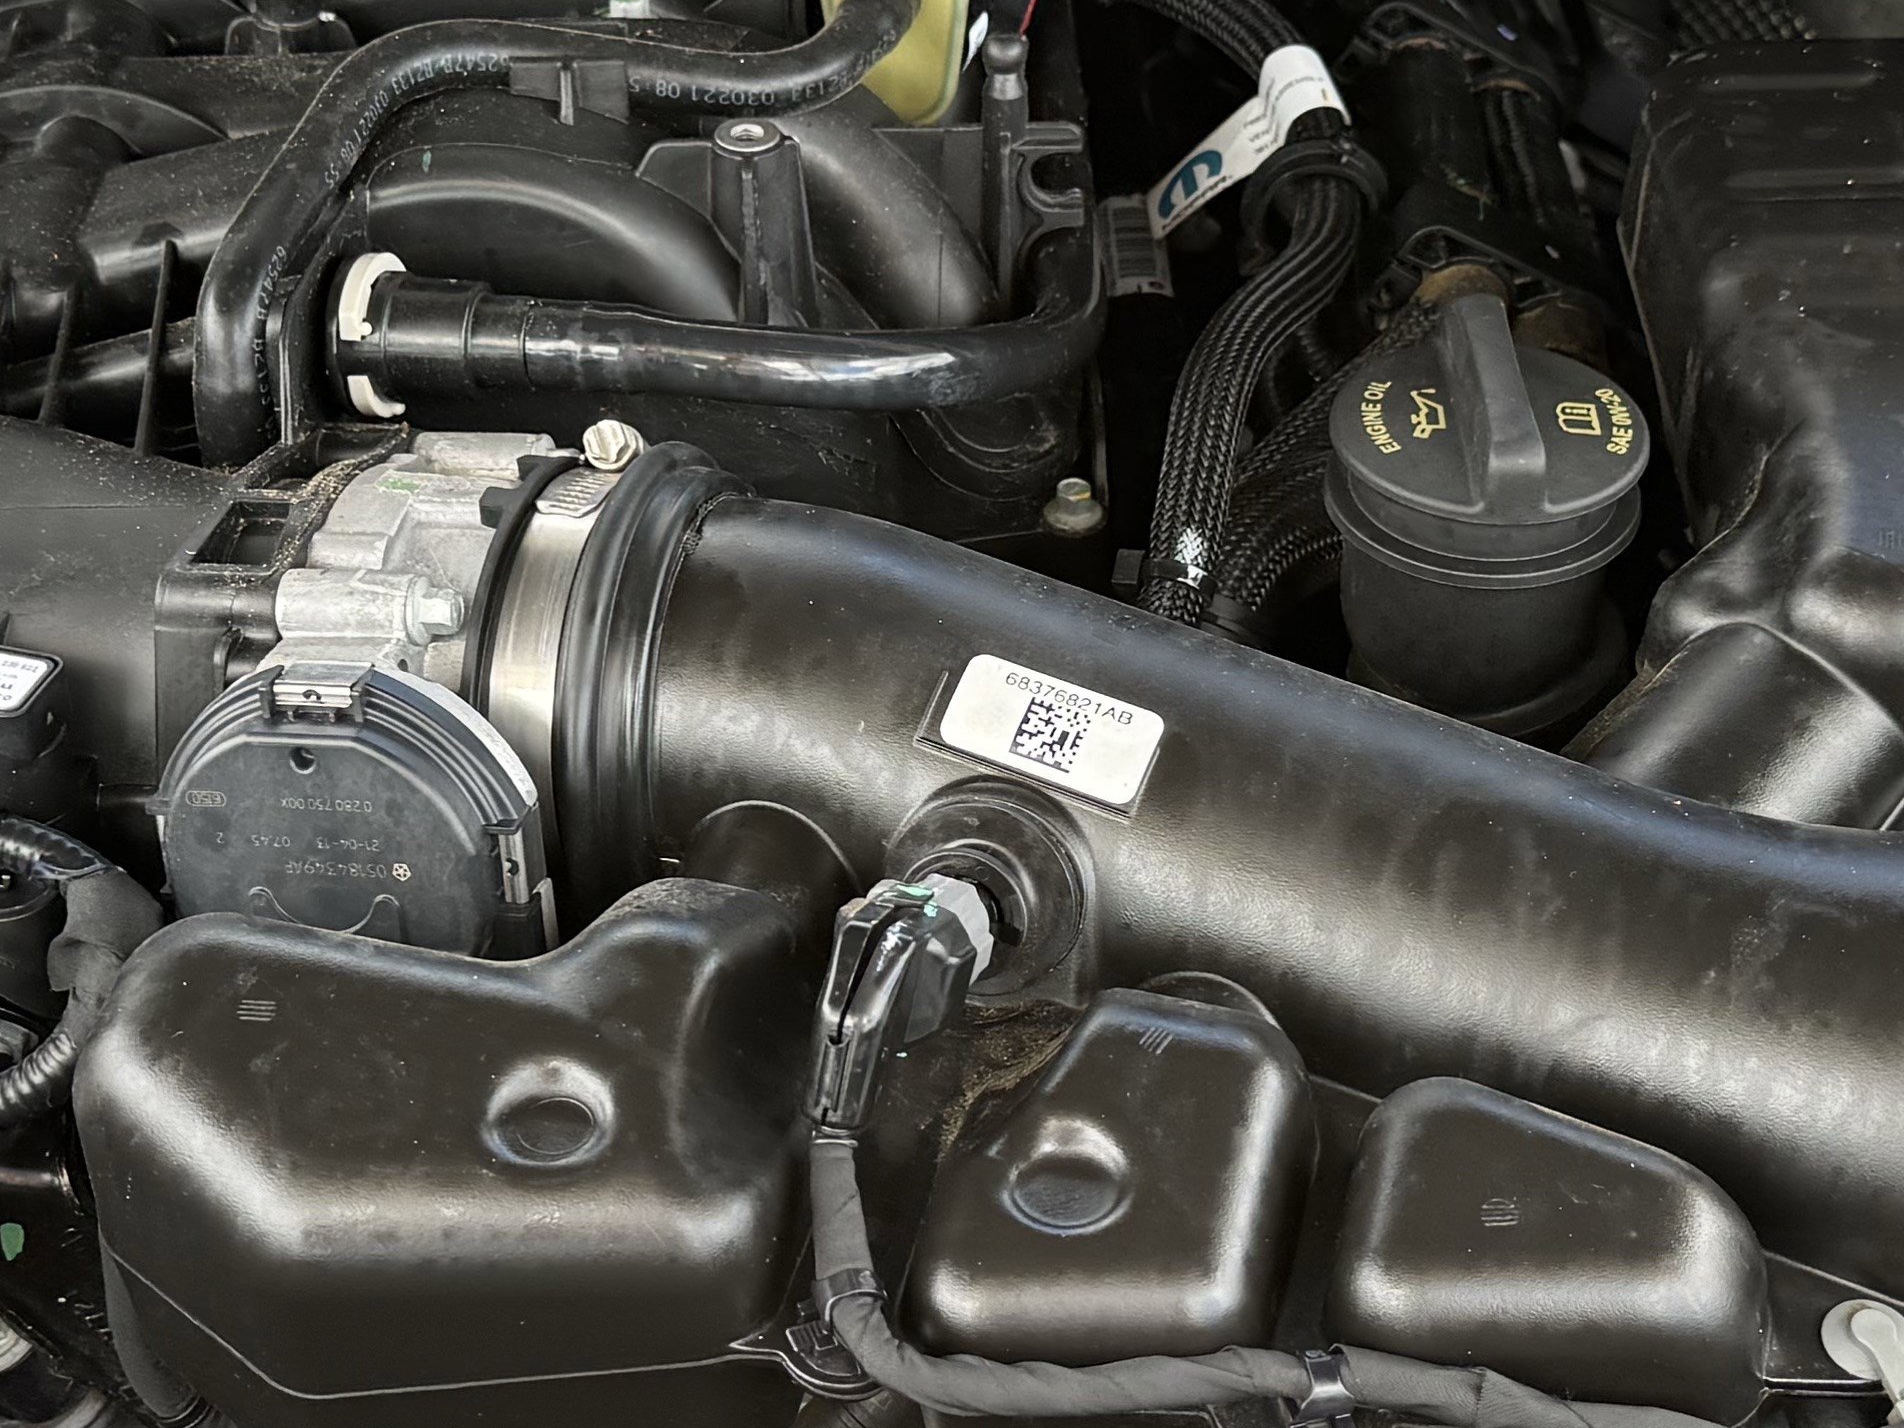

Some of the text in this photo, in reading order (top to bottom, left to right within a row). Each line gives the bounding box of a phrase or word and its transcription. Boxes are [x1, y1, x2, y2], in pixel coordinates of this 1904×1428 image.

[689, 83, 776, 106] 030221
[1359, 380, 1401, 454] ENGINE OIL
[1594, 388, 1634, 455] SAE 0W-20
[1005, 672, 1134, 725] 68376821AB
